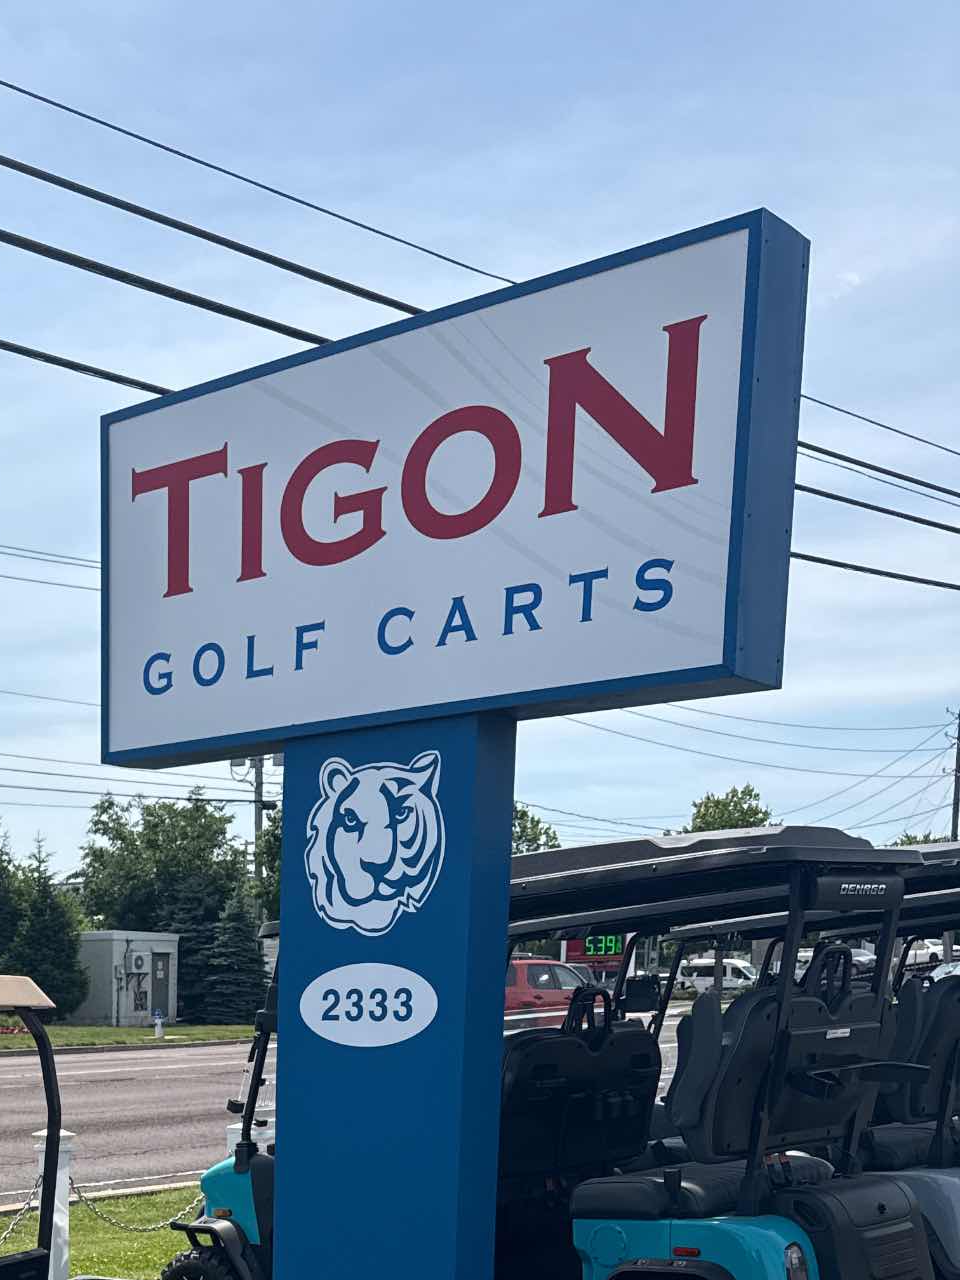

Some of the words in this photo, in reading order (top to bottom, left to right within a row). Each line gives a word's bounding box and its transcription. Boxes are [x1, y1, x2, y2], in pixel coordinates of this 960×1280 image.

[132, 314, 708, 598] TIGON
[142, 621, 326, 696] GOLF
[376, 557, 675, 657] CARTS
[840, 884, 886, 895] DENAGO
[321, 987, 413, 1022] 2333
